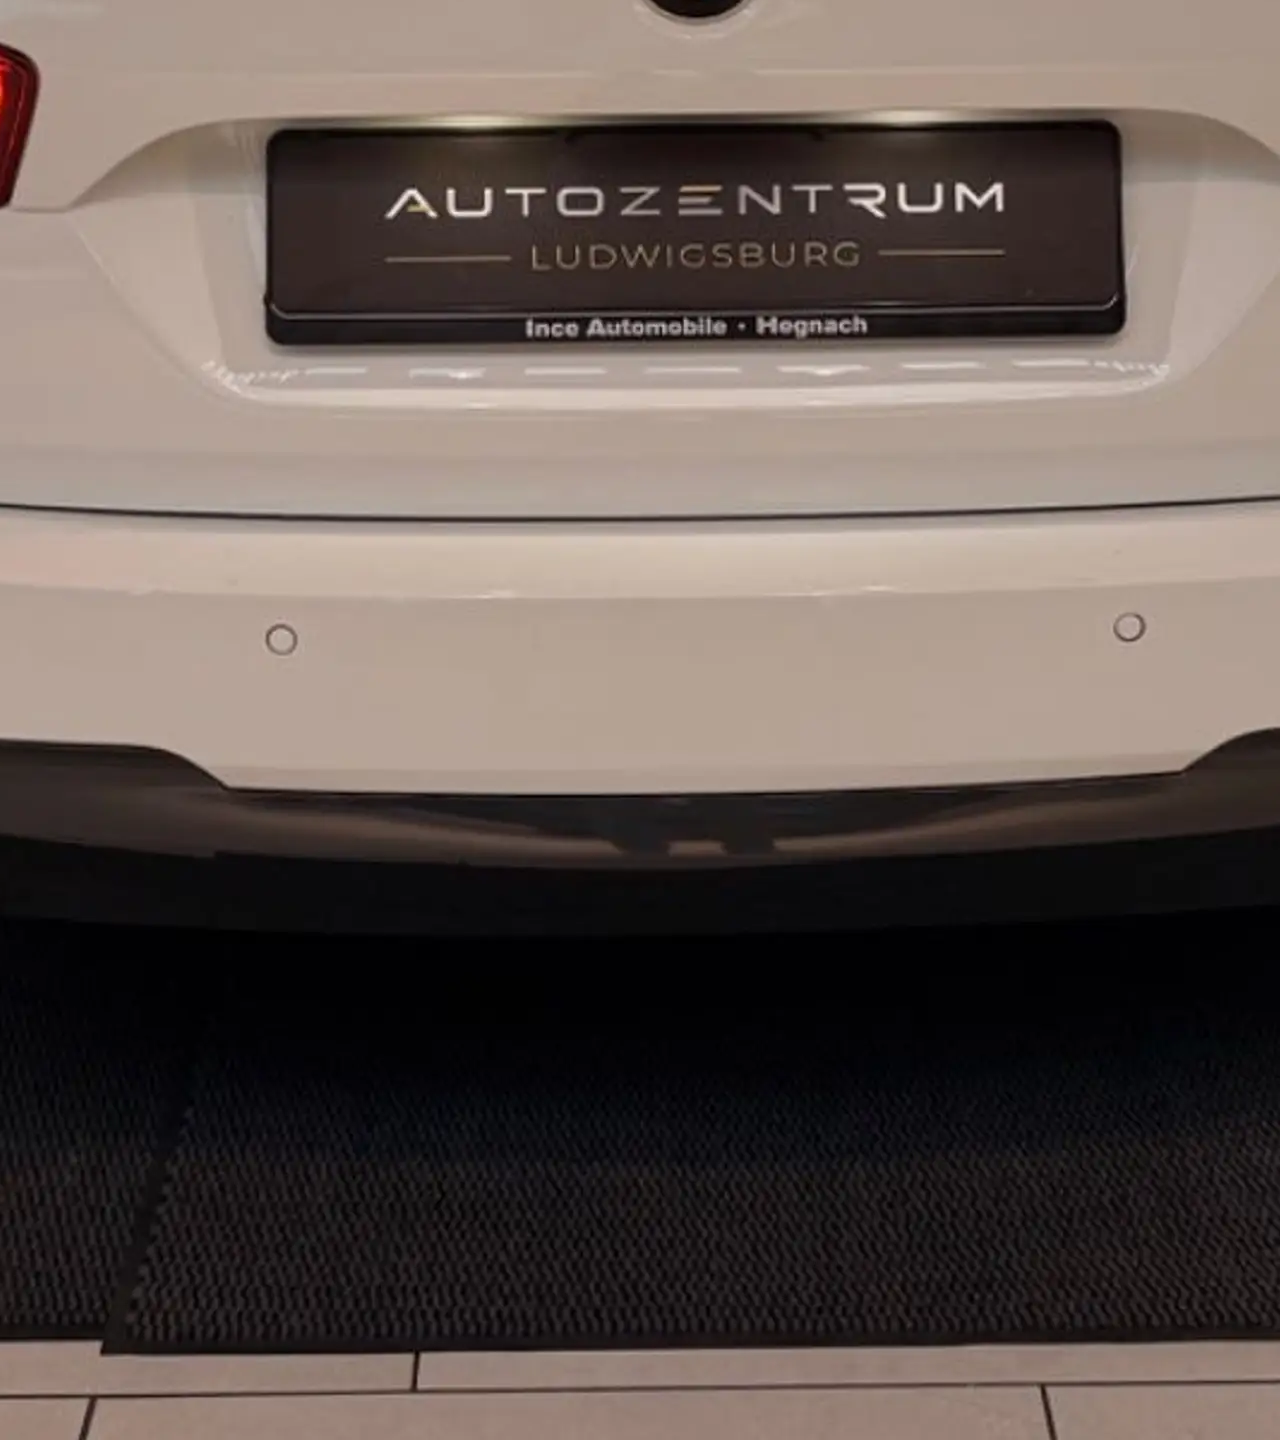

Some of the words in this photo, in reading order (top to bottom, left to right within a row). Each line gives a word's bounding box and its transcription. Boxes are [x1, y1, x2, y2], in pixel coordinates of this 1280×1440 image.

[384, 181, 1006, 220] AUTOZENTRUM
[530, 240, 861, 271] LUDWIGSBURG
[524, 317, 580, 339] Ince
[586, 315, 728, 338] Automobile
